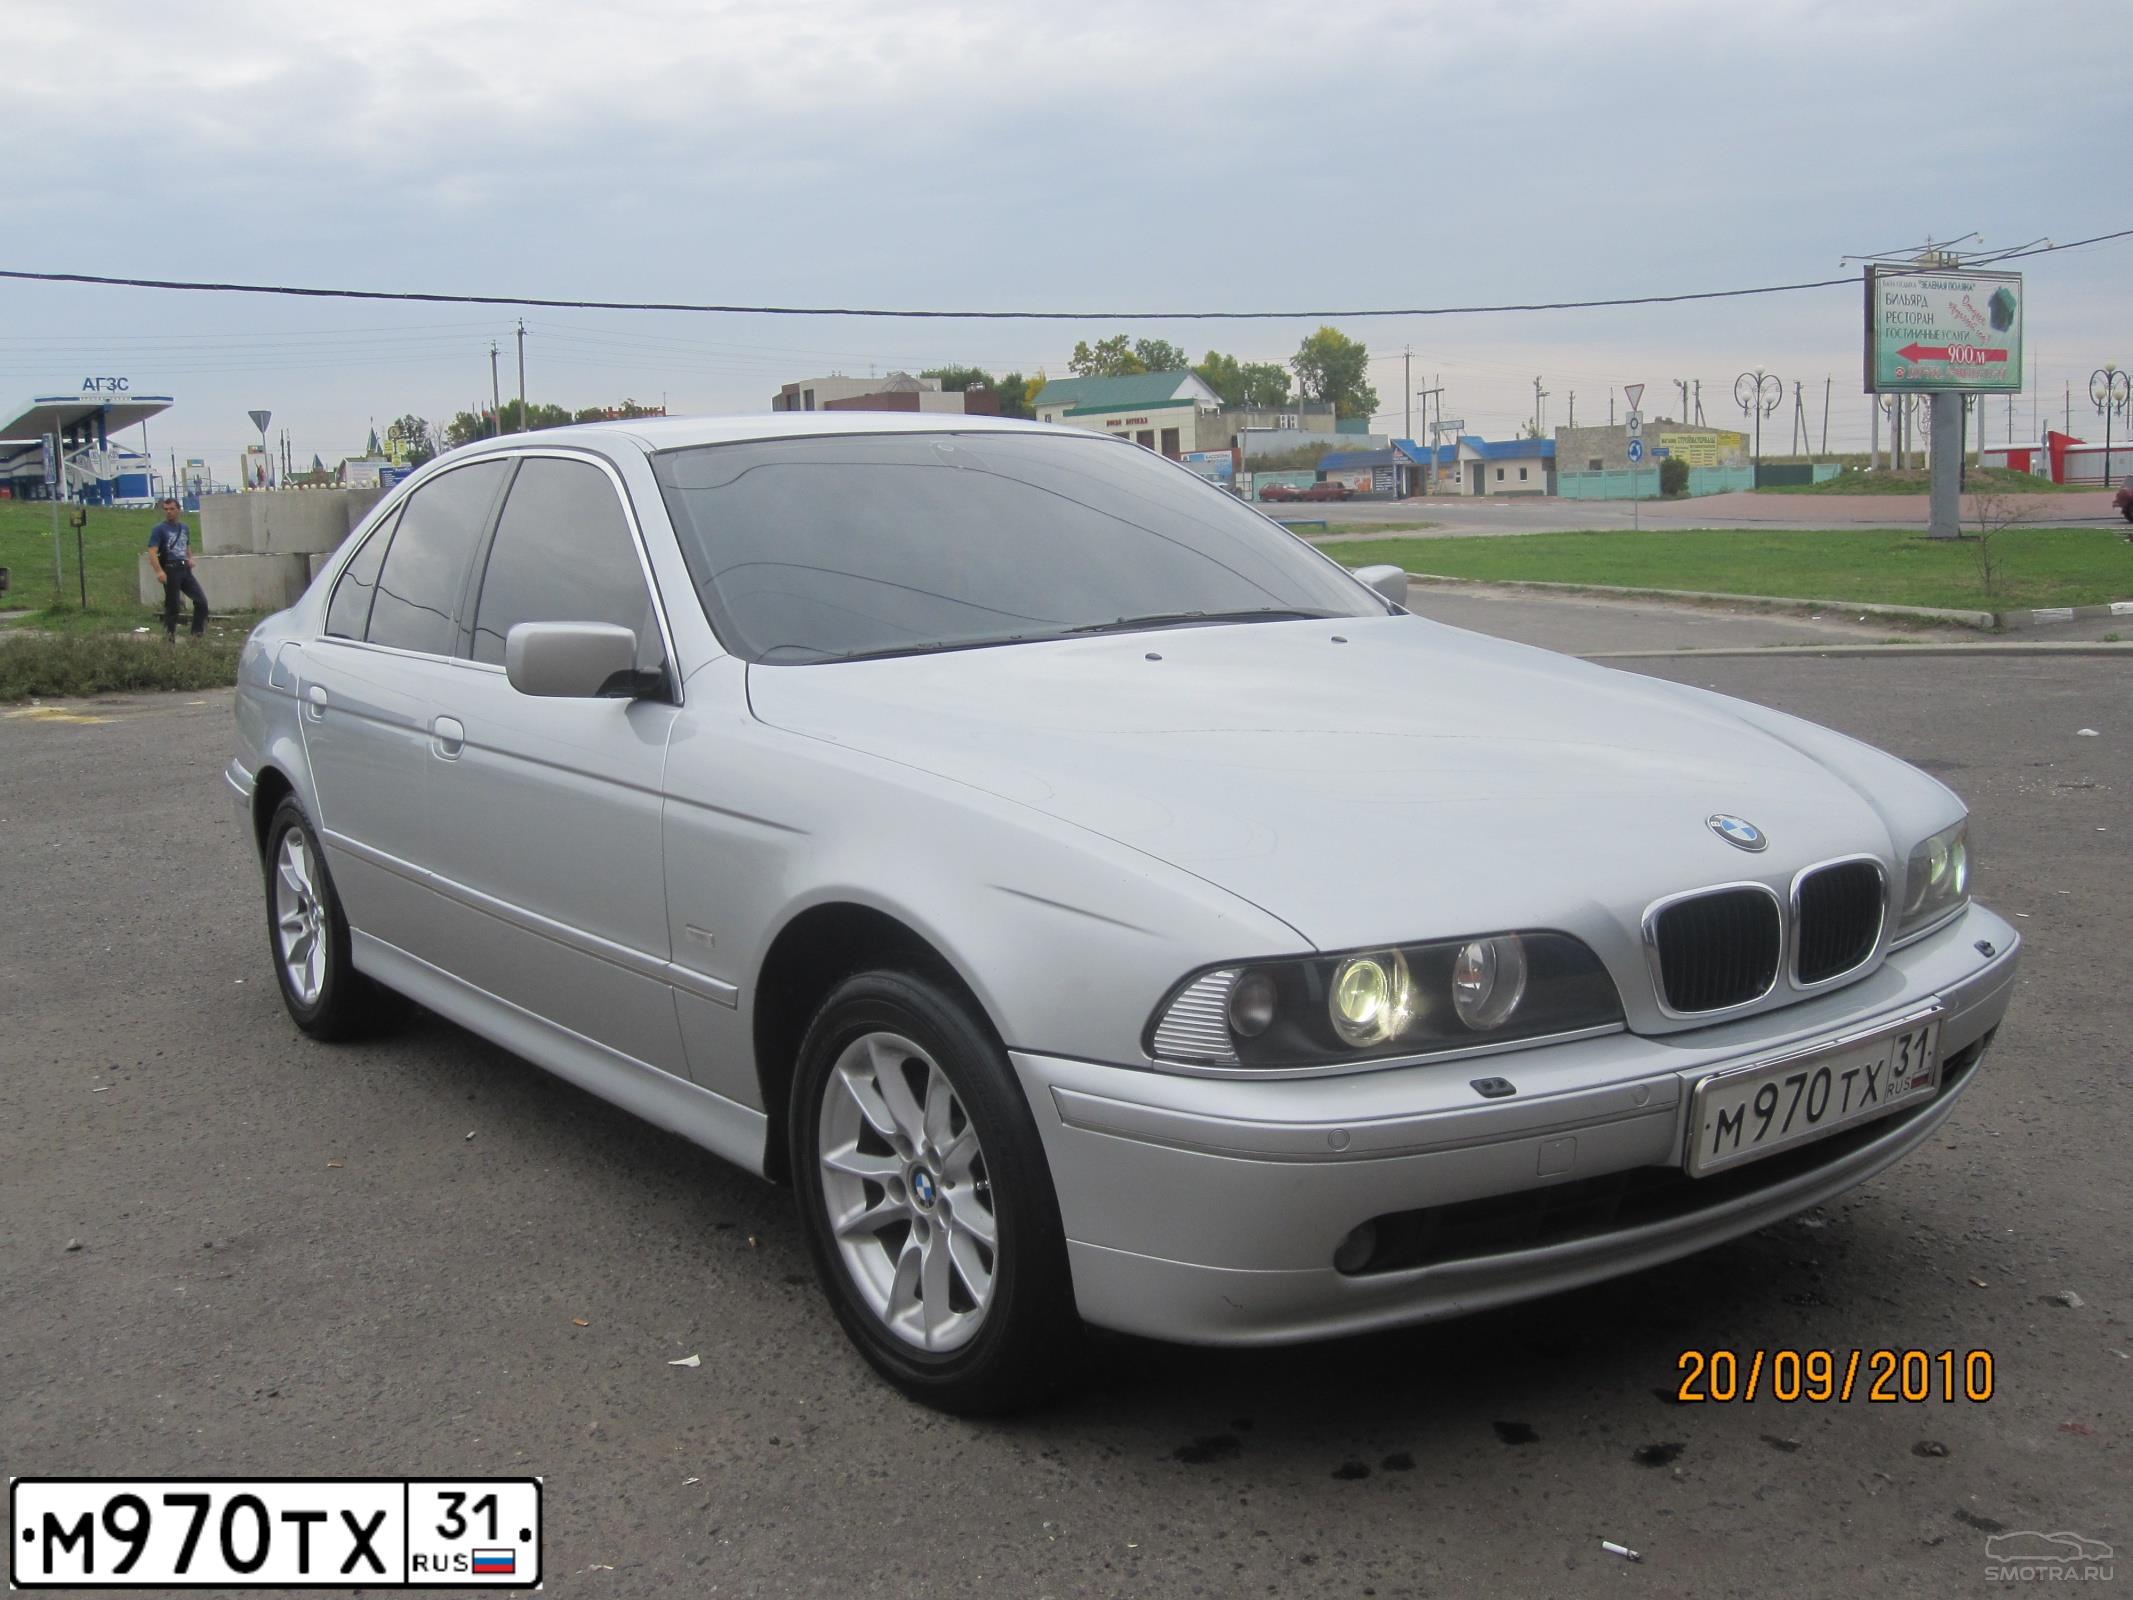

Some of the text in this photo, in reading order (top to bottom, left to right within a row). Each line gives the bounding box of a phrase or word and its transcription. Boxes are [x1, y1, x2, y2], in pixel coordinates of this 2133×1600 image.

[1885, 292, 1928, 308] БИЛЬЯРД
[1885, 311, 1934, 325] РЕСТОРАН
[1885, 327, 1940, 340] ГОСТИНИЧНЫЕ
[1947, 343, 1973, 364] 900
[82, 377, 129, 392] АГЗС
[1894, 1027, 1929, 1077] 31
[1887, 1076, 1911, 1096] RUS
